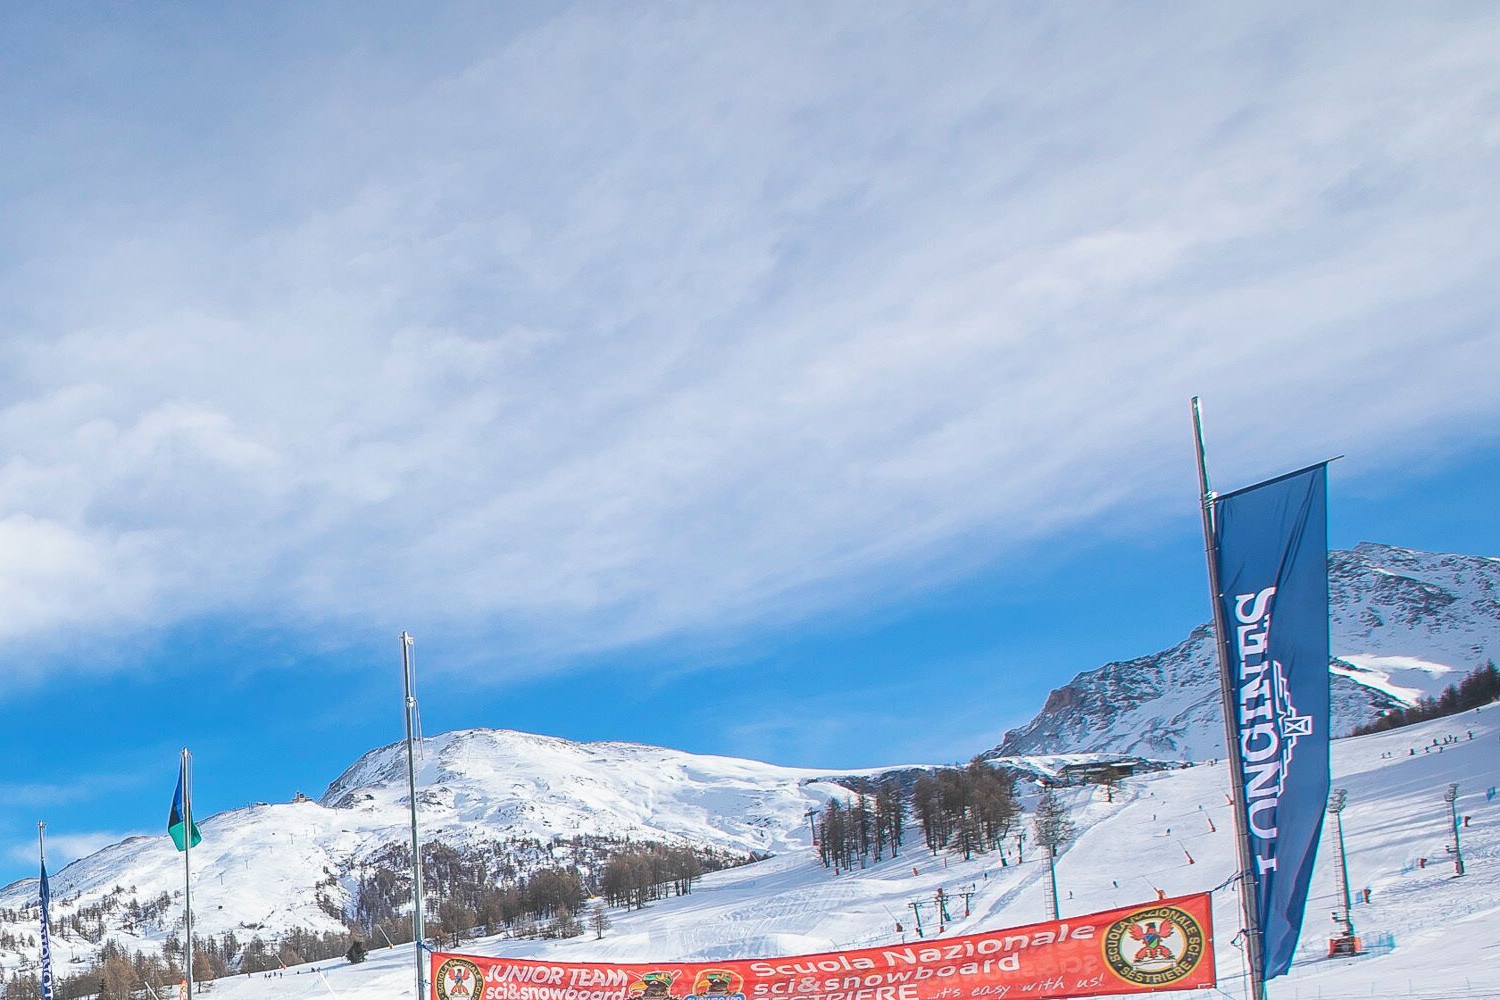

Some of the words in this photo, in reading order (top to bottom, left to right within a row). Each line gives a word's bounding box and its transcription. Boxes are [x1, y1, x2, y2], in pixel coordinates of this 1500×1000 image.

[754, 952, 875, 979] Scuola
[885, 923, 1097, 967] Nazionale
[1107, 920, 1129, 963] SCUOLA
[1130, 908, 1198, 935] NAZIONALE
[1188, 936, 1200, 956] SCI
[485, 963, 566, 985] JUNIOR
[568, 967, 629, 988] TEAM
[753, 952, 1021, 997] sci&snowboard
[970, 982, 1007, 1000] easy
[1021, 975, 1065, 994] with
[1076, 972, 1105, 989] us!
[1119, 961, 1192, 983] SESTRIERE
